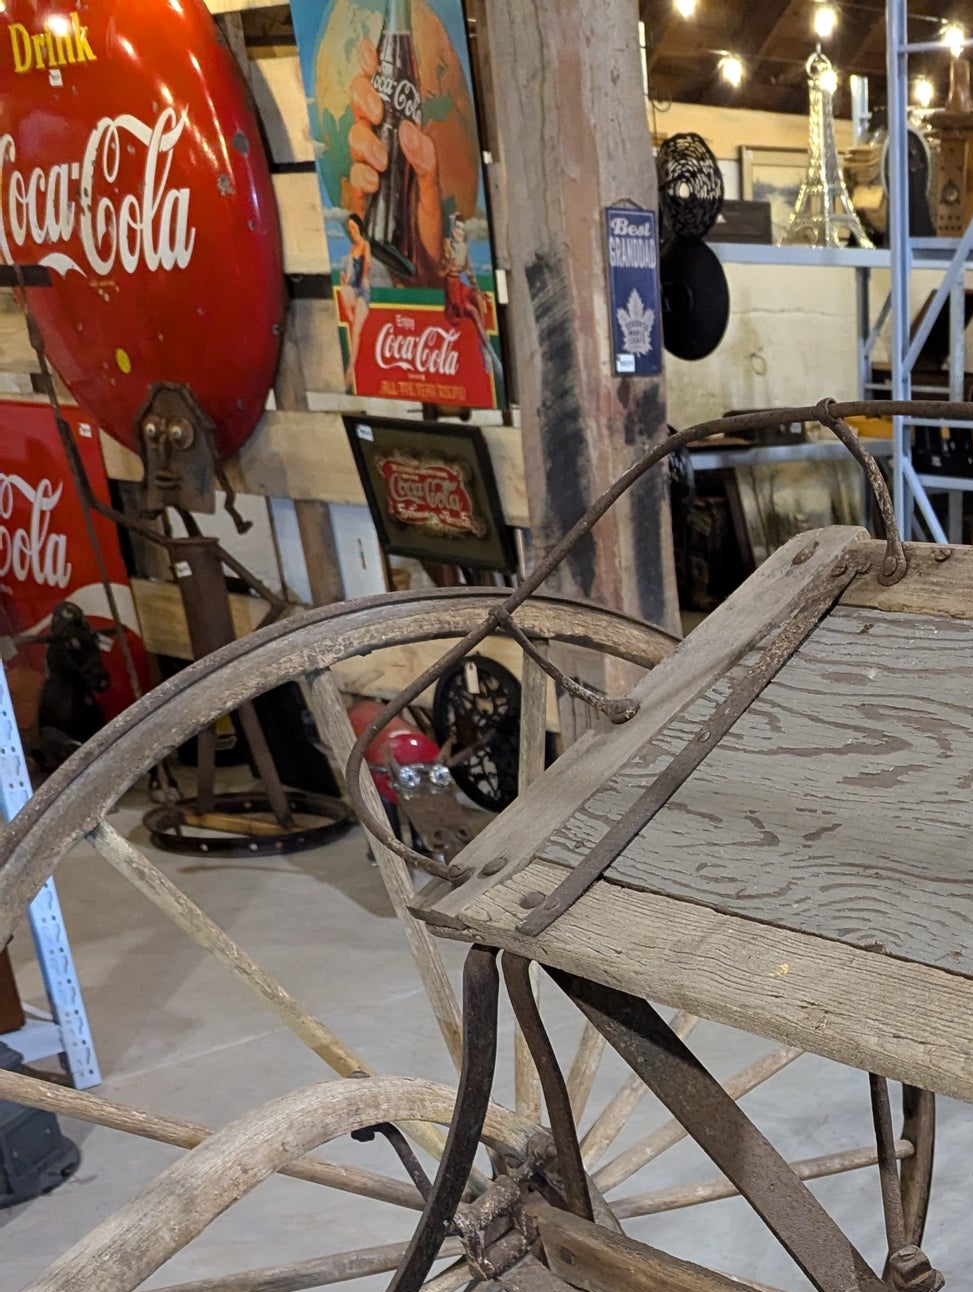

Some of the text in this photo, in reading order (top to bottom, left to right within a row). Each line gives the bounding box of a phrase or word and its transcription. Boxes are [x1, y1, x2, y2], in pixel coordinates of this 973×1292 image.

[8, 12, 97, 73] Drink
[371, 72, 422, 126] oca-Cola
[609, 236, 657, 269] GRANDDAD
[610, 217, 651, 237] Best
[375, 323, 462, 376] Coca-Cola
